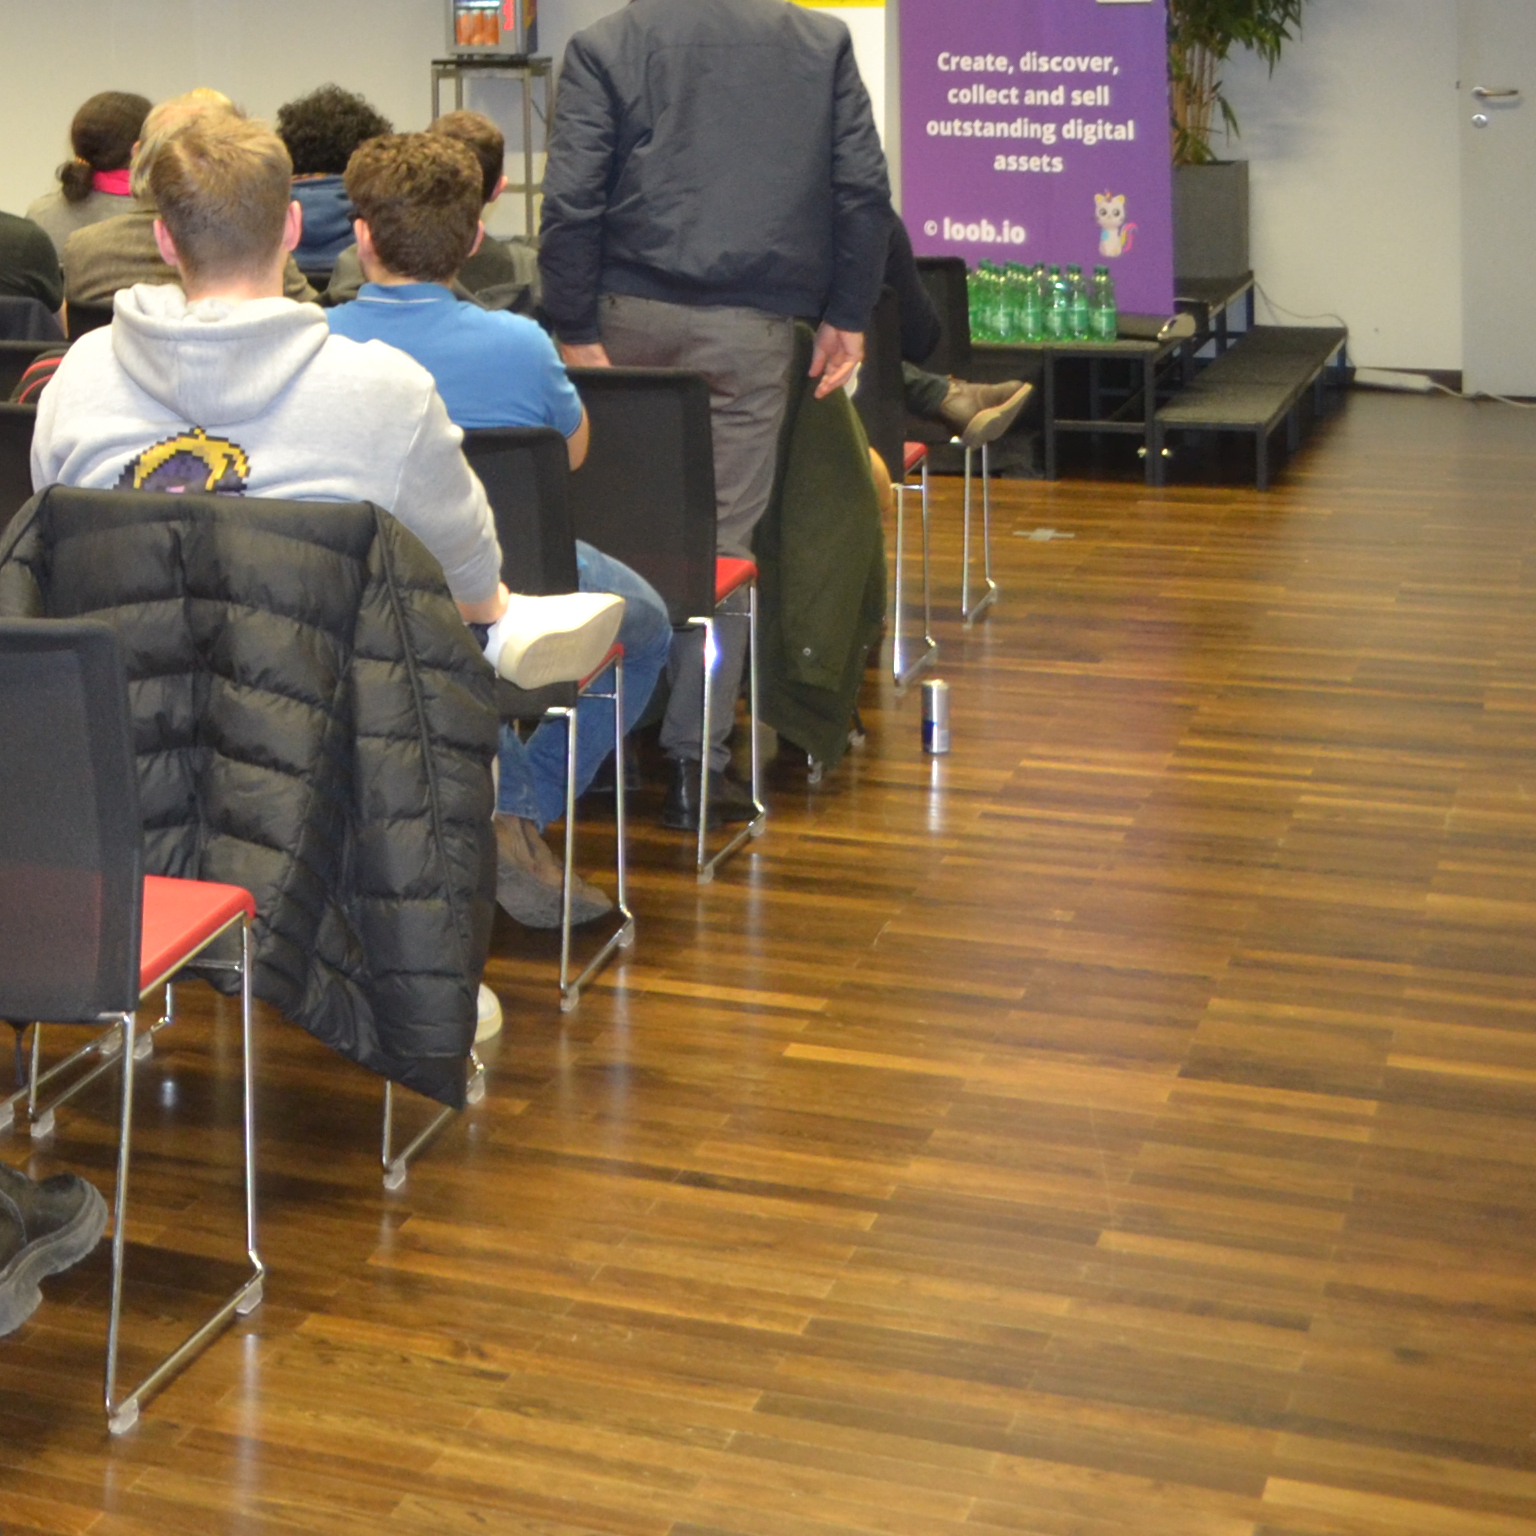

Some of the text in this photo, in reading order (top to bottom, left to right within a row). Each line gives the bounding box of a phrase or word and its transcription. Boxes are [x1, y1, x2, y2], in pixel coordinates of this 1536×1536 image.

[937, 51, 1120, 76] Create, discover,
[947, 83, 1110, 106] collect and sell
[926, 118, 1135, 146] outstanding digital
[993, 154, 1064, 173] assets
[943, 216, 1026, 244] loob.io
